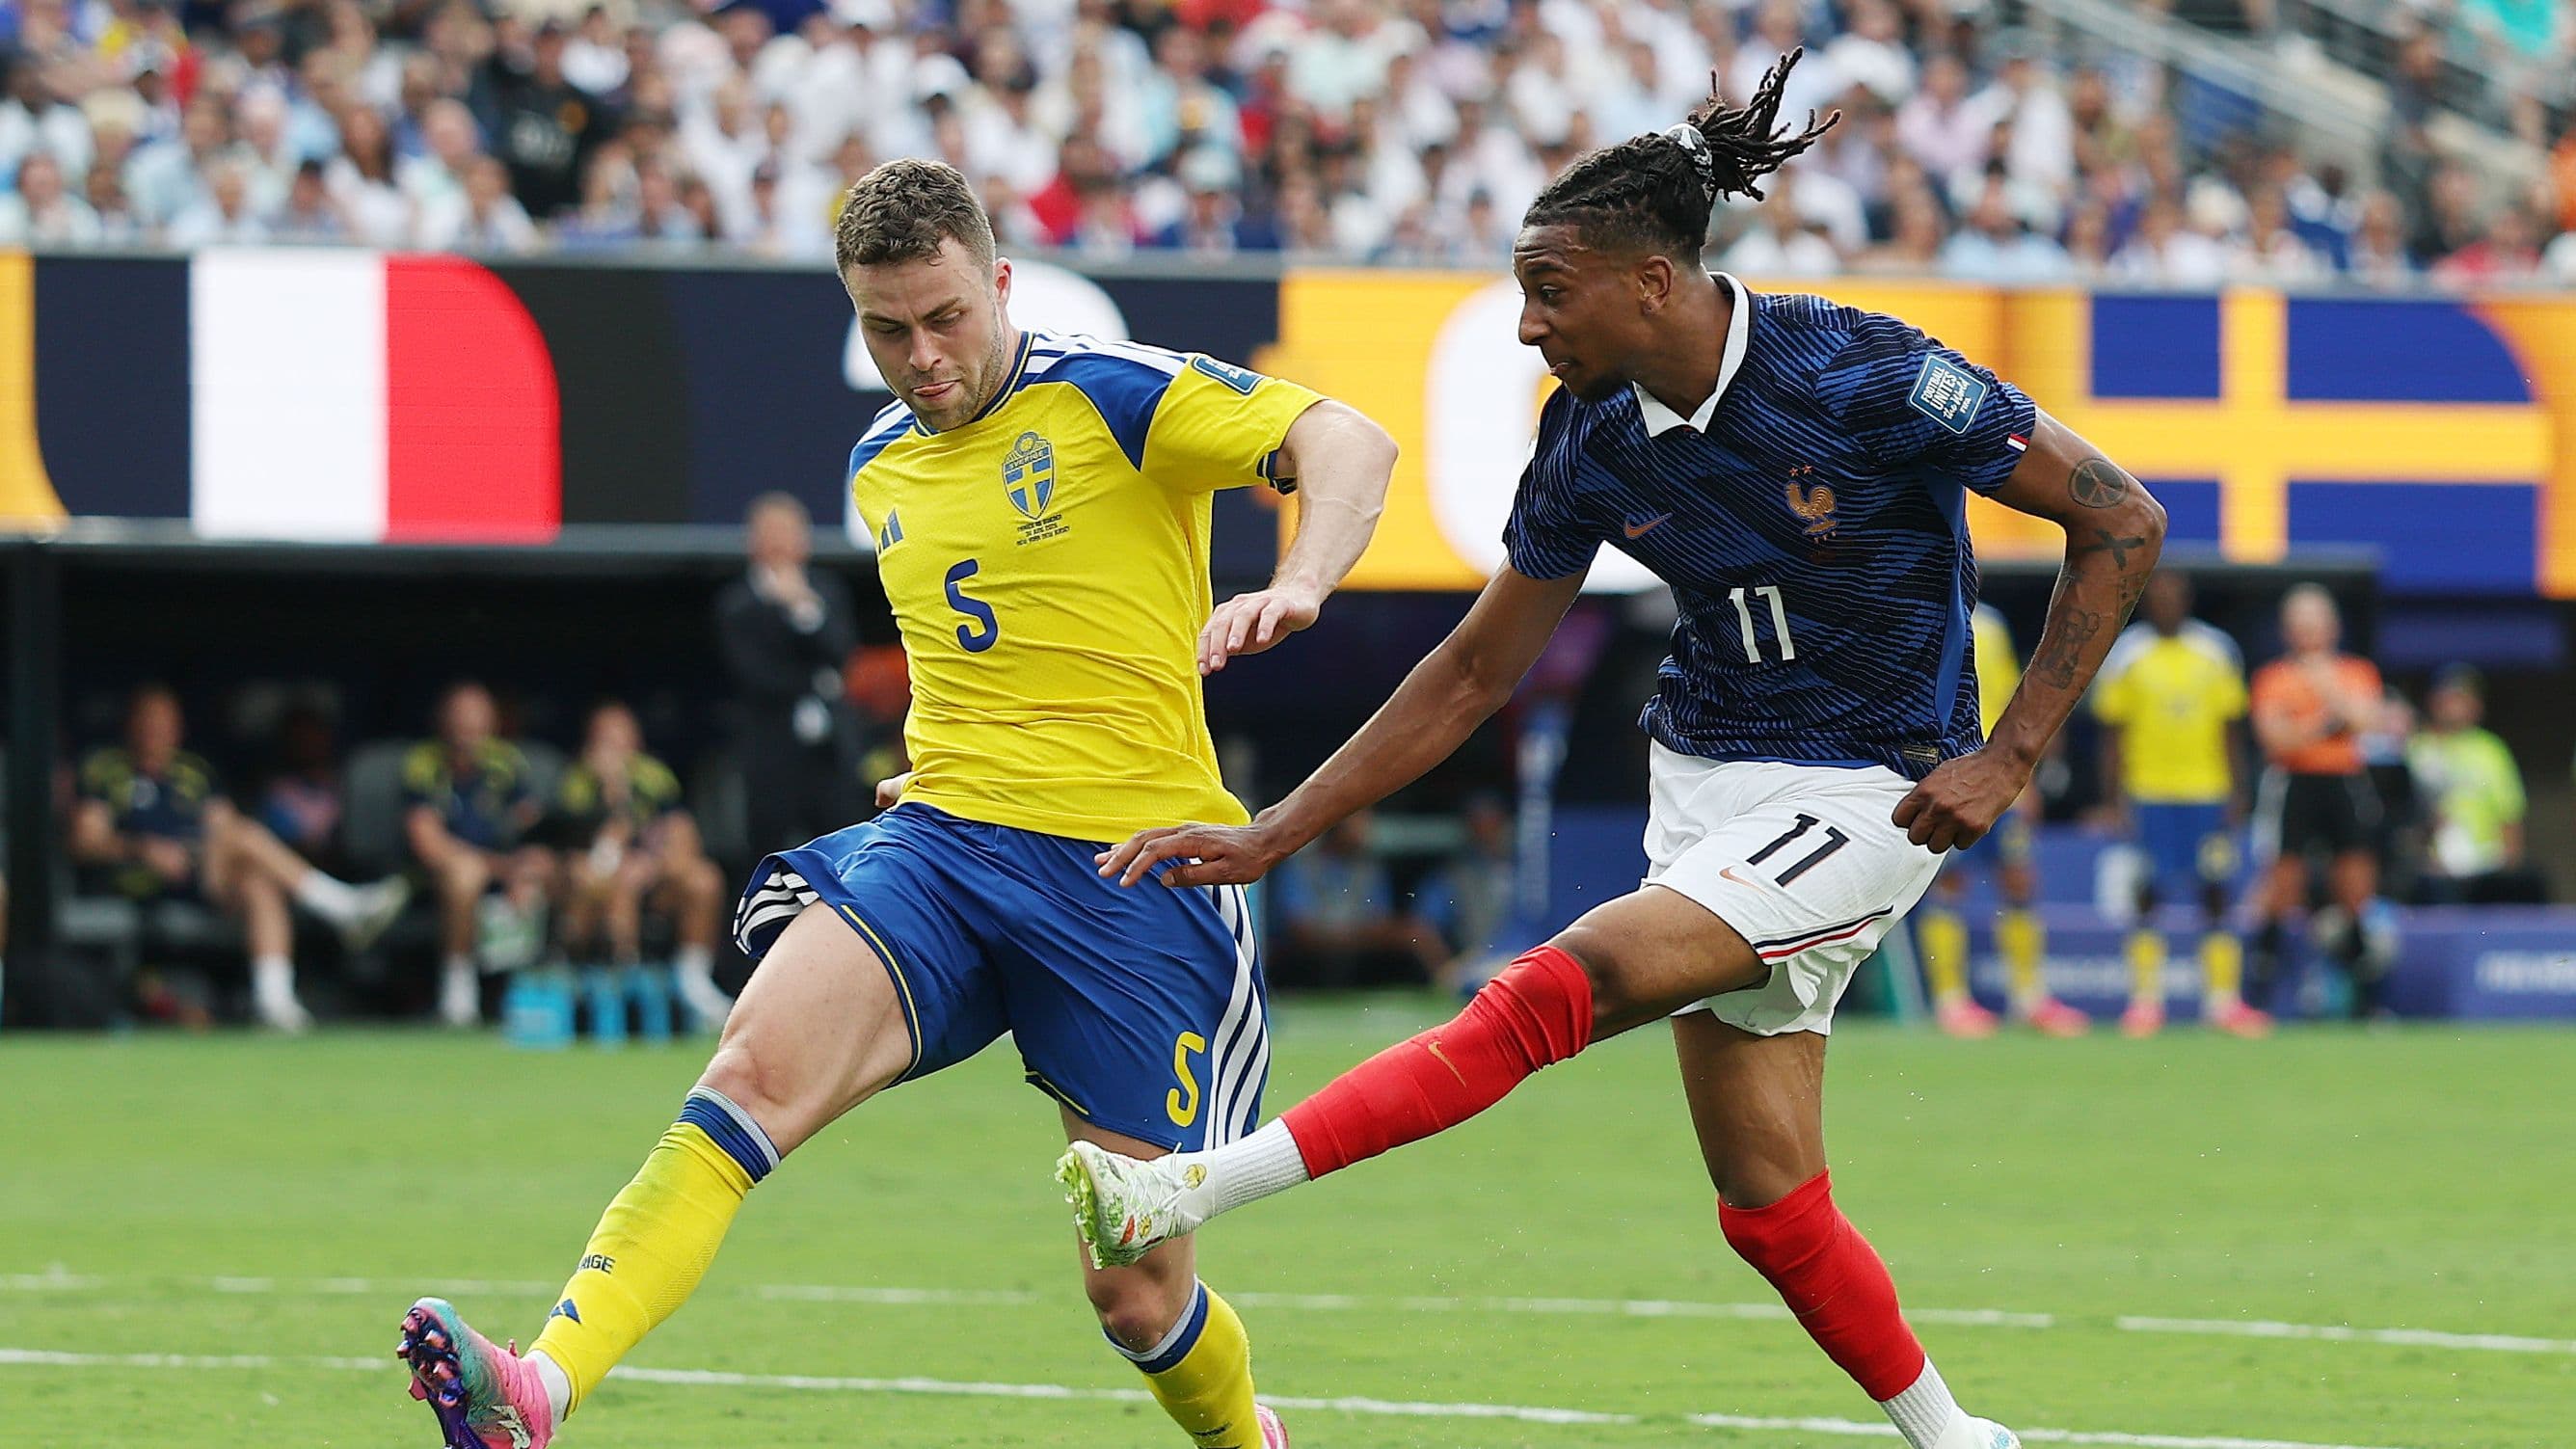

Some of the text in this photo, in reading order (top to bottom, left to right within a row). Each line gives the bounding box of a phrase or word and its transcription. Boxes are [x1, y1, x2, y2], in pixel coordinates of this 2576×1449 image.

[1920, 366, 1945, 403] FOOTBALL
[1930, 371, 1957, 411] UNITES
[1943, 376, 1971, 420] the World
[945, 558, 998, 653] 5
[1728, 585, 1795, 663] 11
[1746, 813, 1850, 887] 11
[1166, 1031, 1206, 1128] 5
